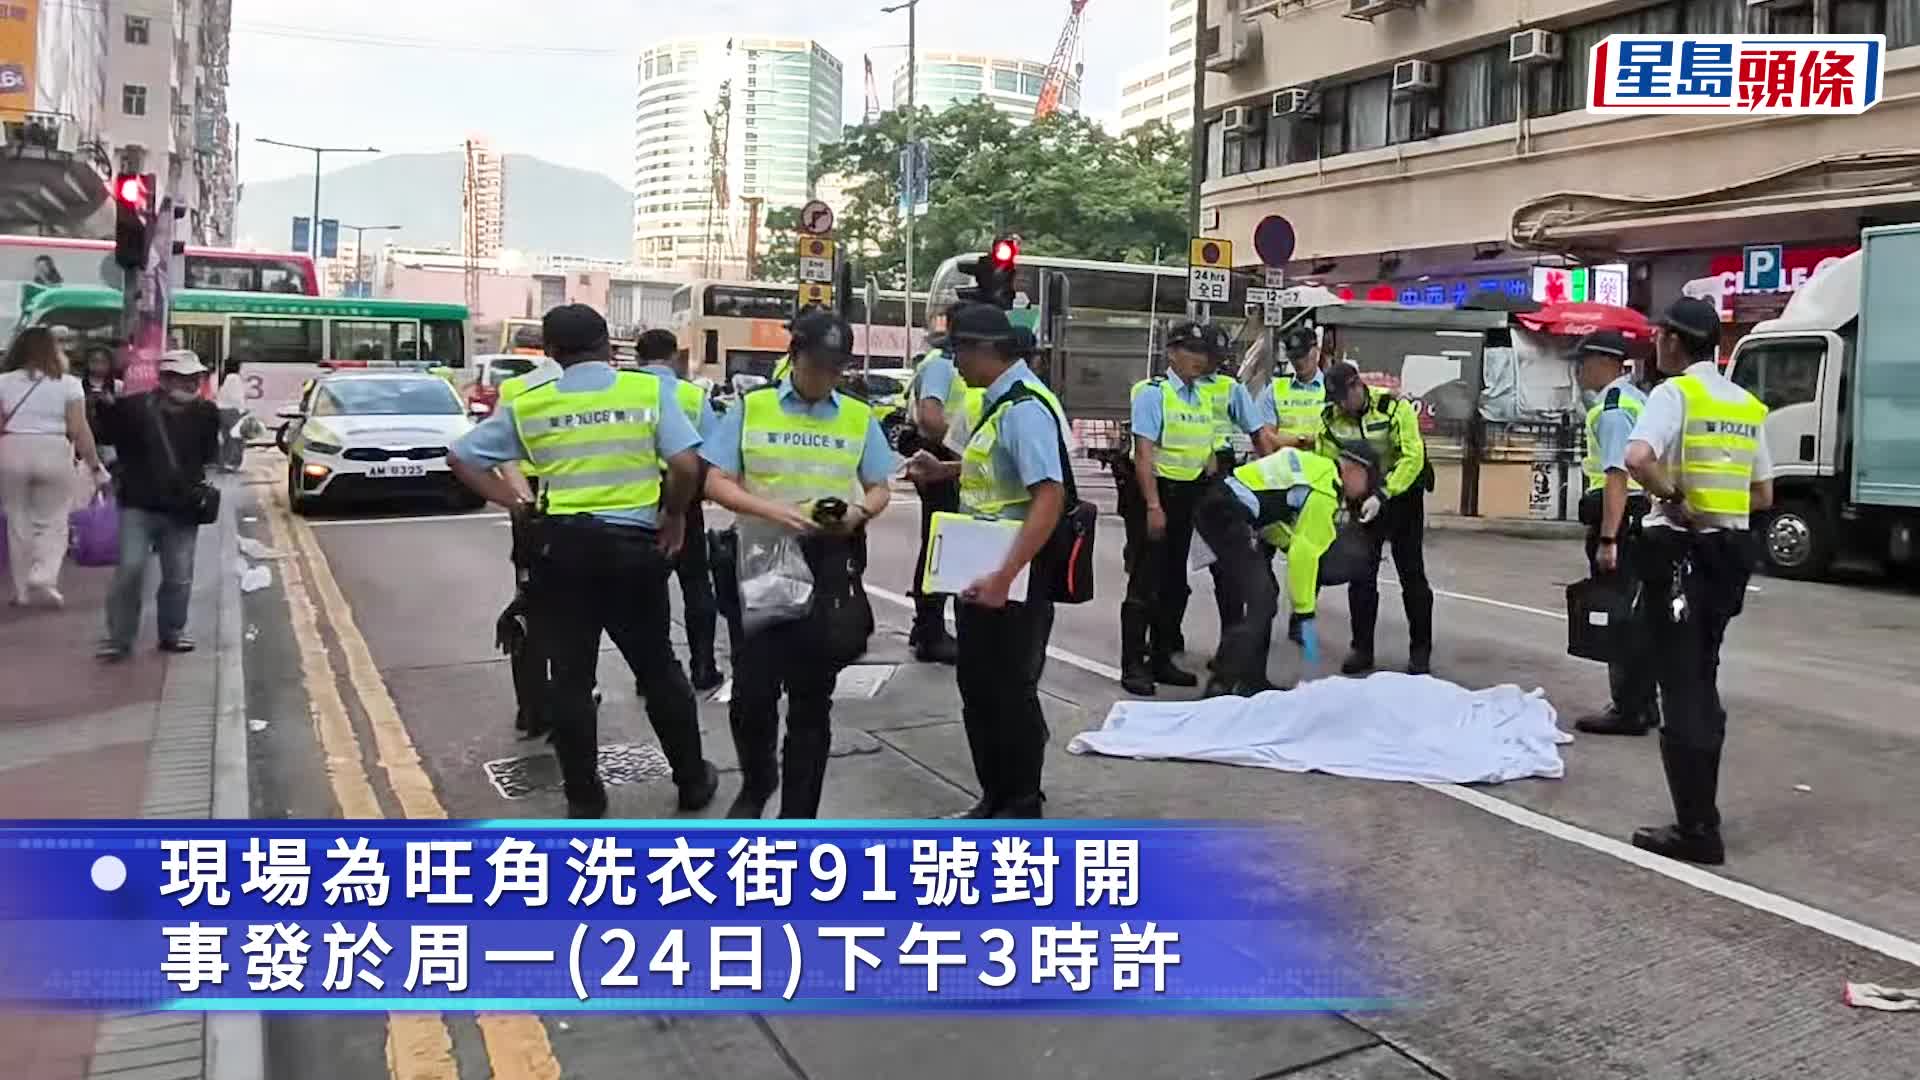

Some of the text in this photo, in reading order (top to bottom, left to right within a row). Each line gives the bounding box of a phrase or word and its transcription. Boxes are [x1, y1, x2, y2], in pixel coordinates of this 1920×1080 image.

[1749, 250, 1775, 286] P
[1194, 270, 1225, 282] 24 hrs
[1198, 283, 1223, 298] 全日
[783, 432, 831, 447] POLICE
